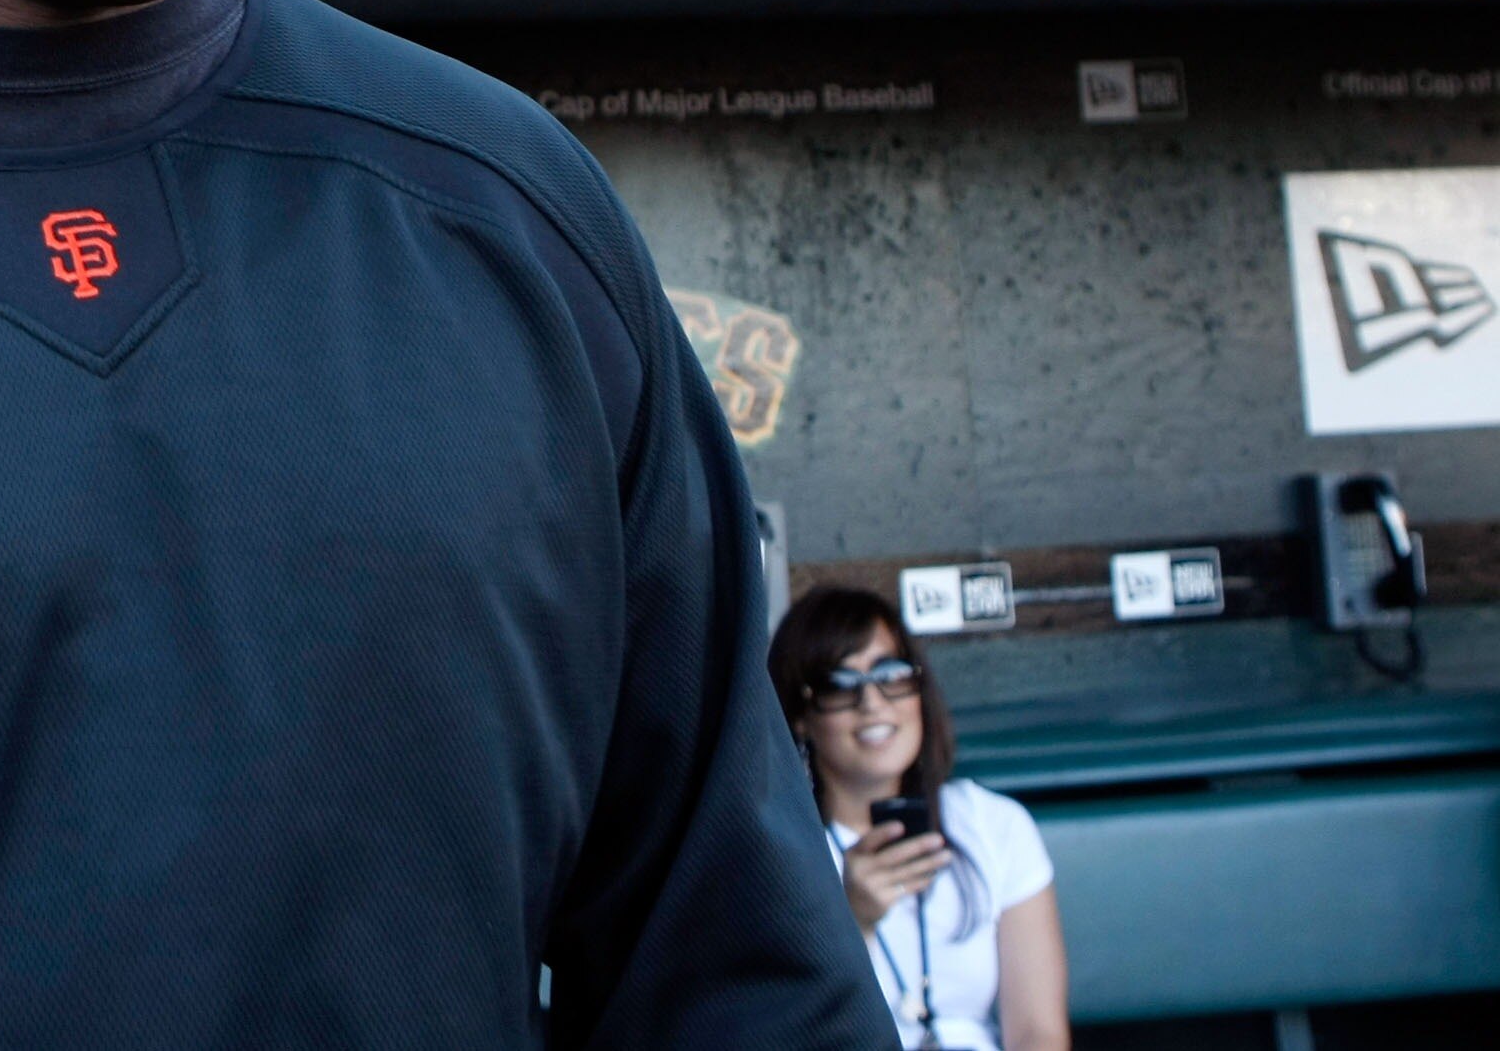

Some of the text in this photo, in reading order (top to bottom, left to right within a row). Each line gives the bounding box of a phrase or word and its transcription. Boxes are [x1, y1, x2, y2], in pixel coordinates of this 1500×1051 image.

[602, 90, 628, 116] of
[635, 88, 713, 120] Major
[718, 86, 816, 119] League
[821, 82, 935, 110] Baseball
